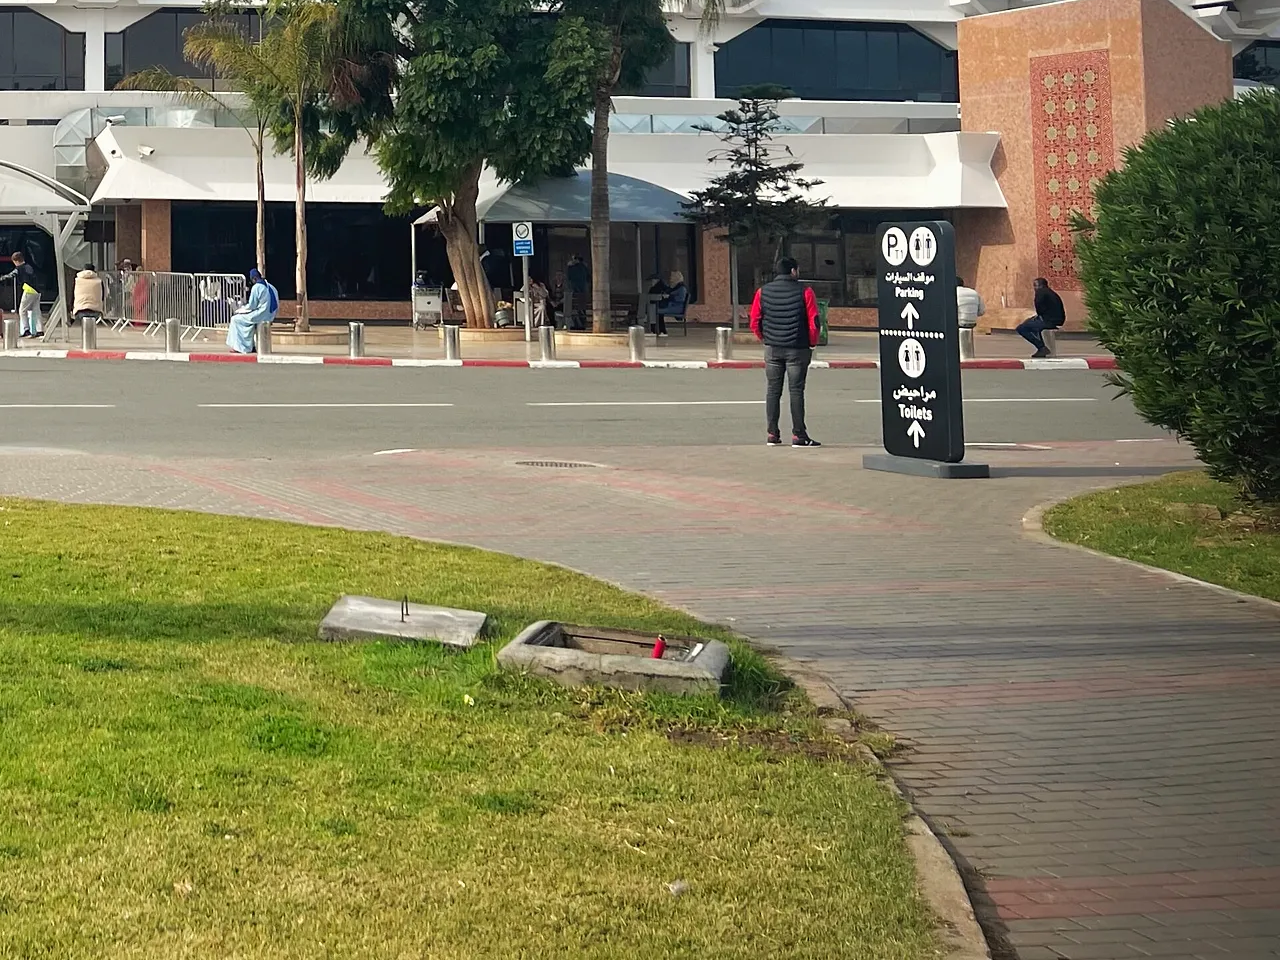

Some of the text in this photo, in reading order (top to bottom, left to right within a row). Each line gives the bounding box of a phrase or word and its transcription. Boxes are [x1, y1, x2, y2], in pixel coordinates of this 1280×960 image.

[887, 233, 898, 257] P
[895, 286, 924, 301] Parking
[892, 384, 937, 403] مراحيض
[898, 403, 933, 421] Toilets
